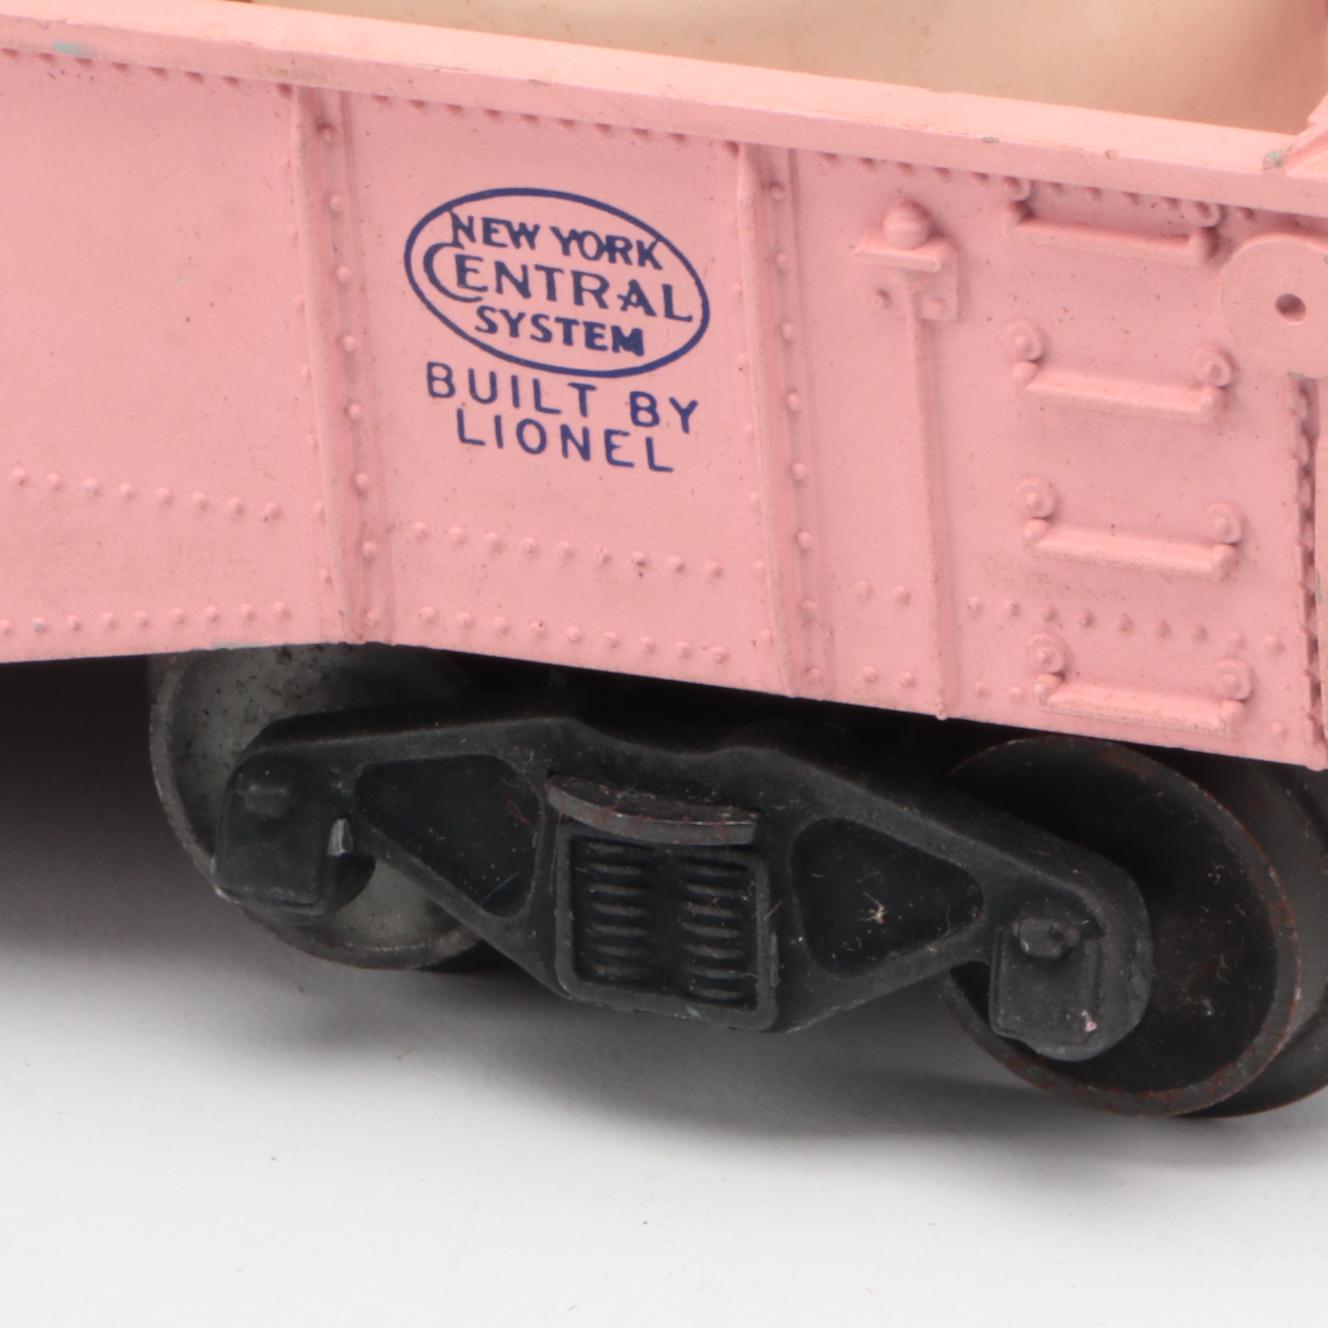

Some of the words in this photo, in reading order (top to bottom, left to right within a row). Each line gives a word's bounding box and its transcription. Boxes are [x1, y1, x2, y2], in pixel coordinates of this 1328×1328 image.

[450, 210, 540, 250] NEW
[550, 225, 663, 270] YORK
[423, 242, 693, 322] CENTRAL
[475, 305, 645, 357] SYSTEM
[427, 361, 597, 418] BUILT
[629, 390, 698, 434] BY
[457, 408, 674, 472] LIONEL
